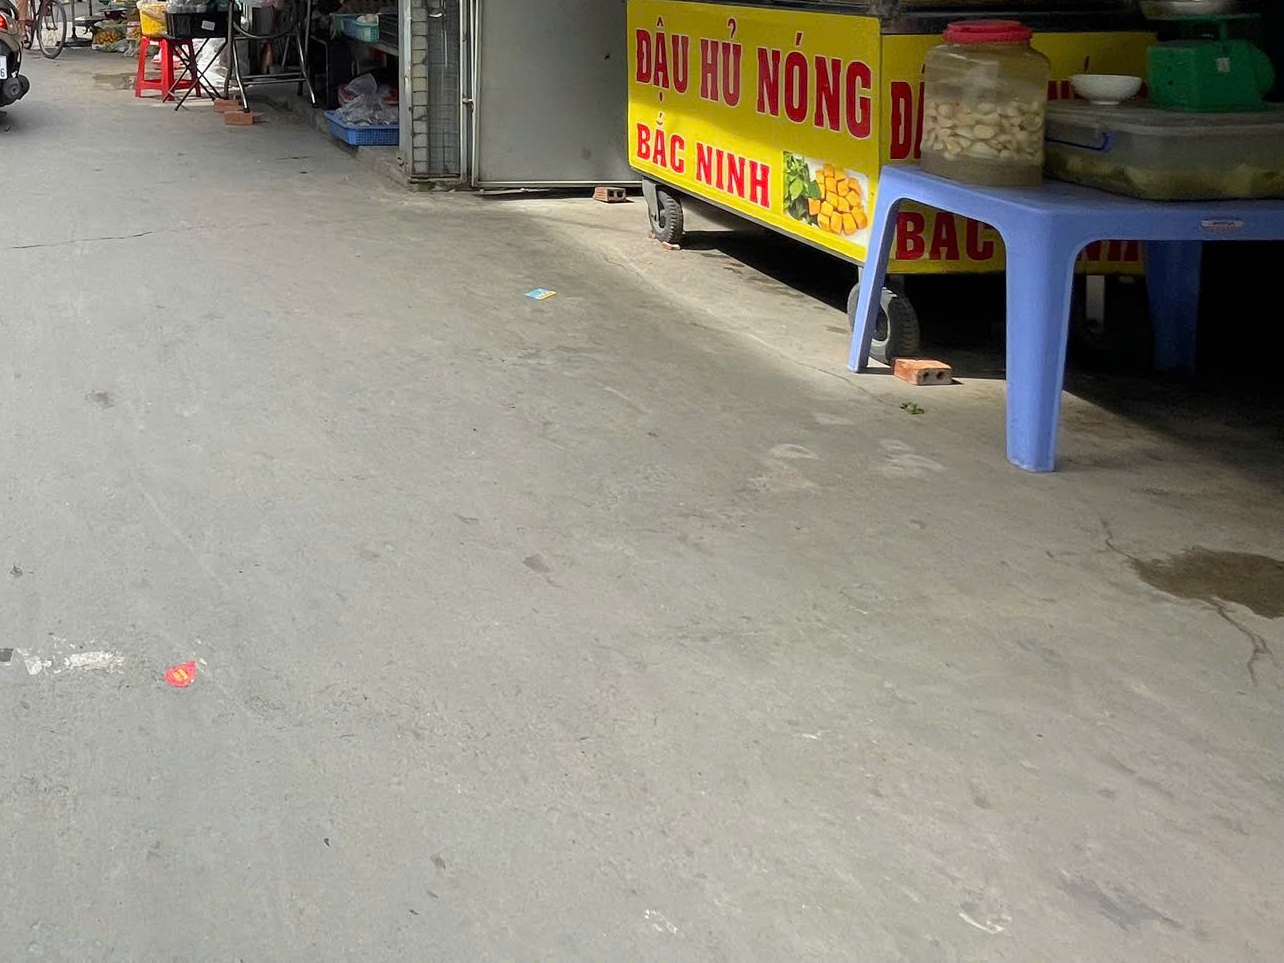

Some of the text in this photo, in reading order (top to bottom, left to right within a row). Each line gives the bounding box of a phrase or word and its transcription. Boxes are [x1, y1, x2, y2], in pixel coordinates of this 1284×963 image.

[635, 16, 689, 102] ĐẬU
[700, 18, 743, 107] HỦ
[756, 32, 872, 139] NÓNG
[636, 113, 770, 209] BẮC NINH
